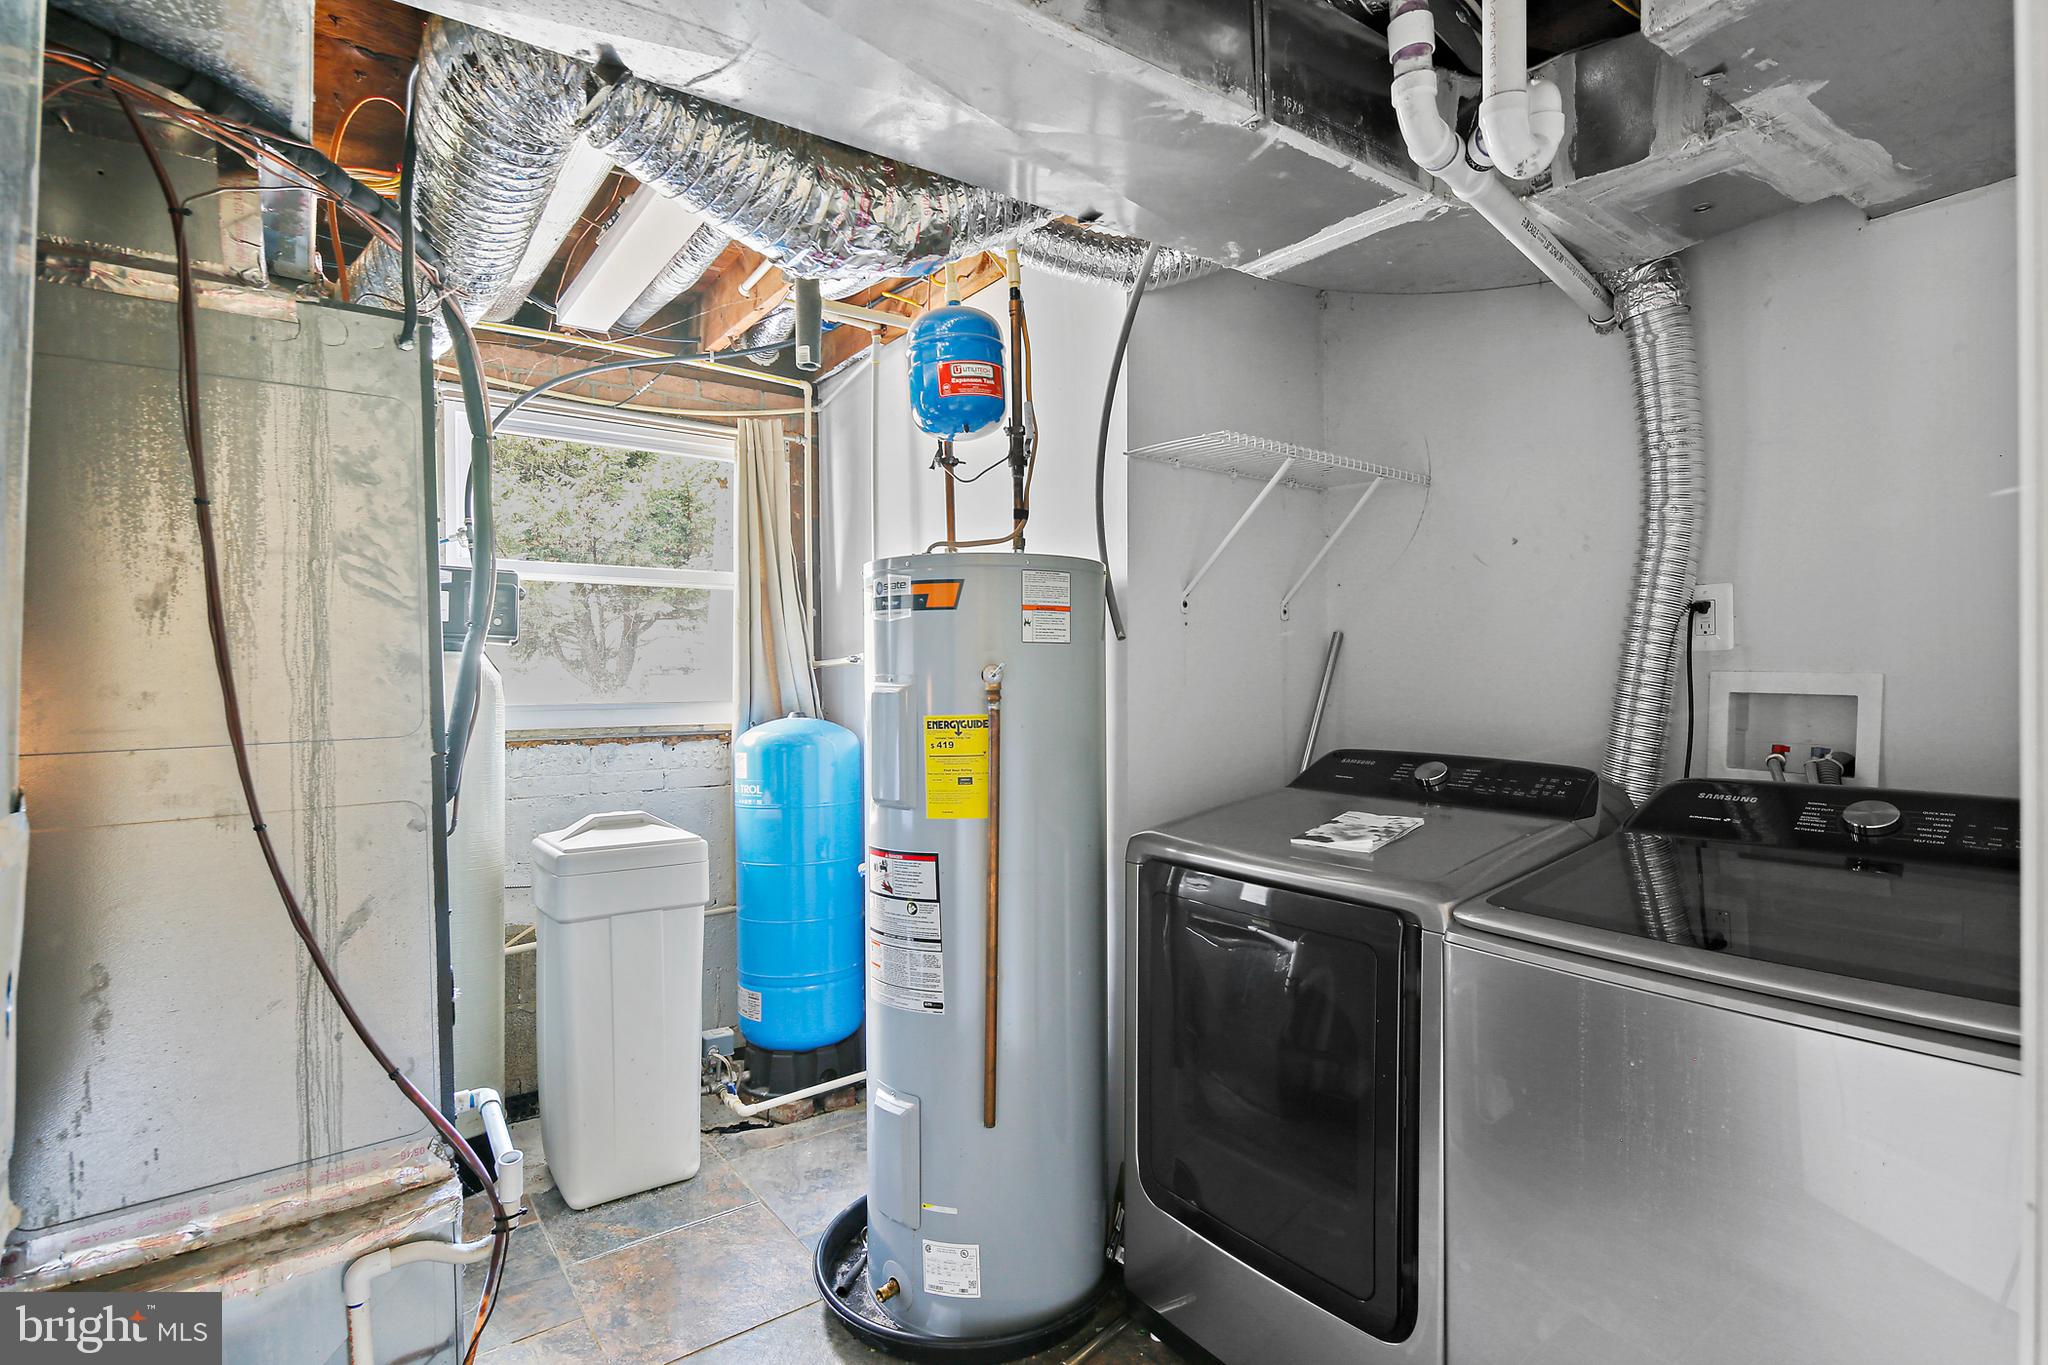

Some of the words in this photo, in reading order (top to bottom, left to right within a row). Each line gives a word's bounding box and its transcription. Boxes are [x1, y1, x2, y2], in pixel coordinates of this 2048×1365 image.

[883, 581, 907, 590] sate
[937, 741, 954, 749] 419
[740, 784, 763, 794] TROL
[1698, 792, 1758, 803] SAMSUNG
